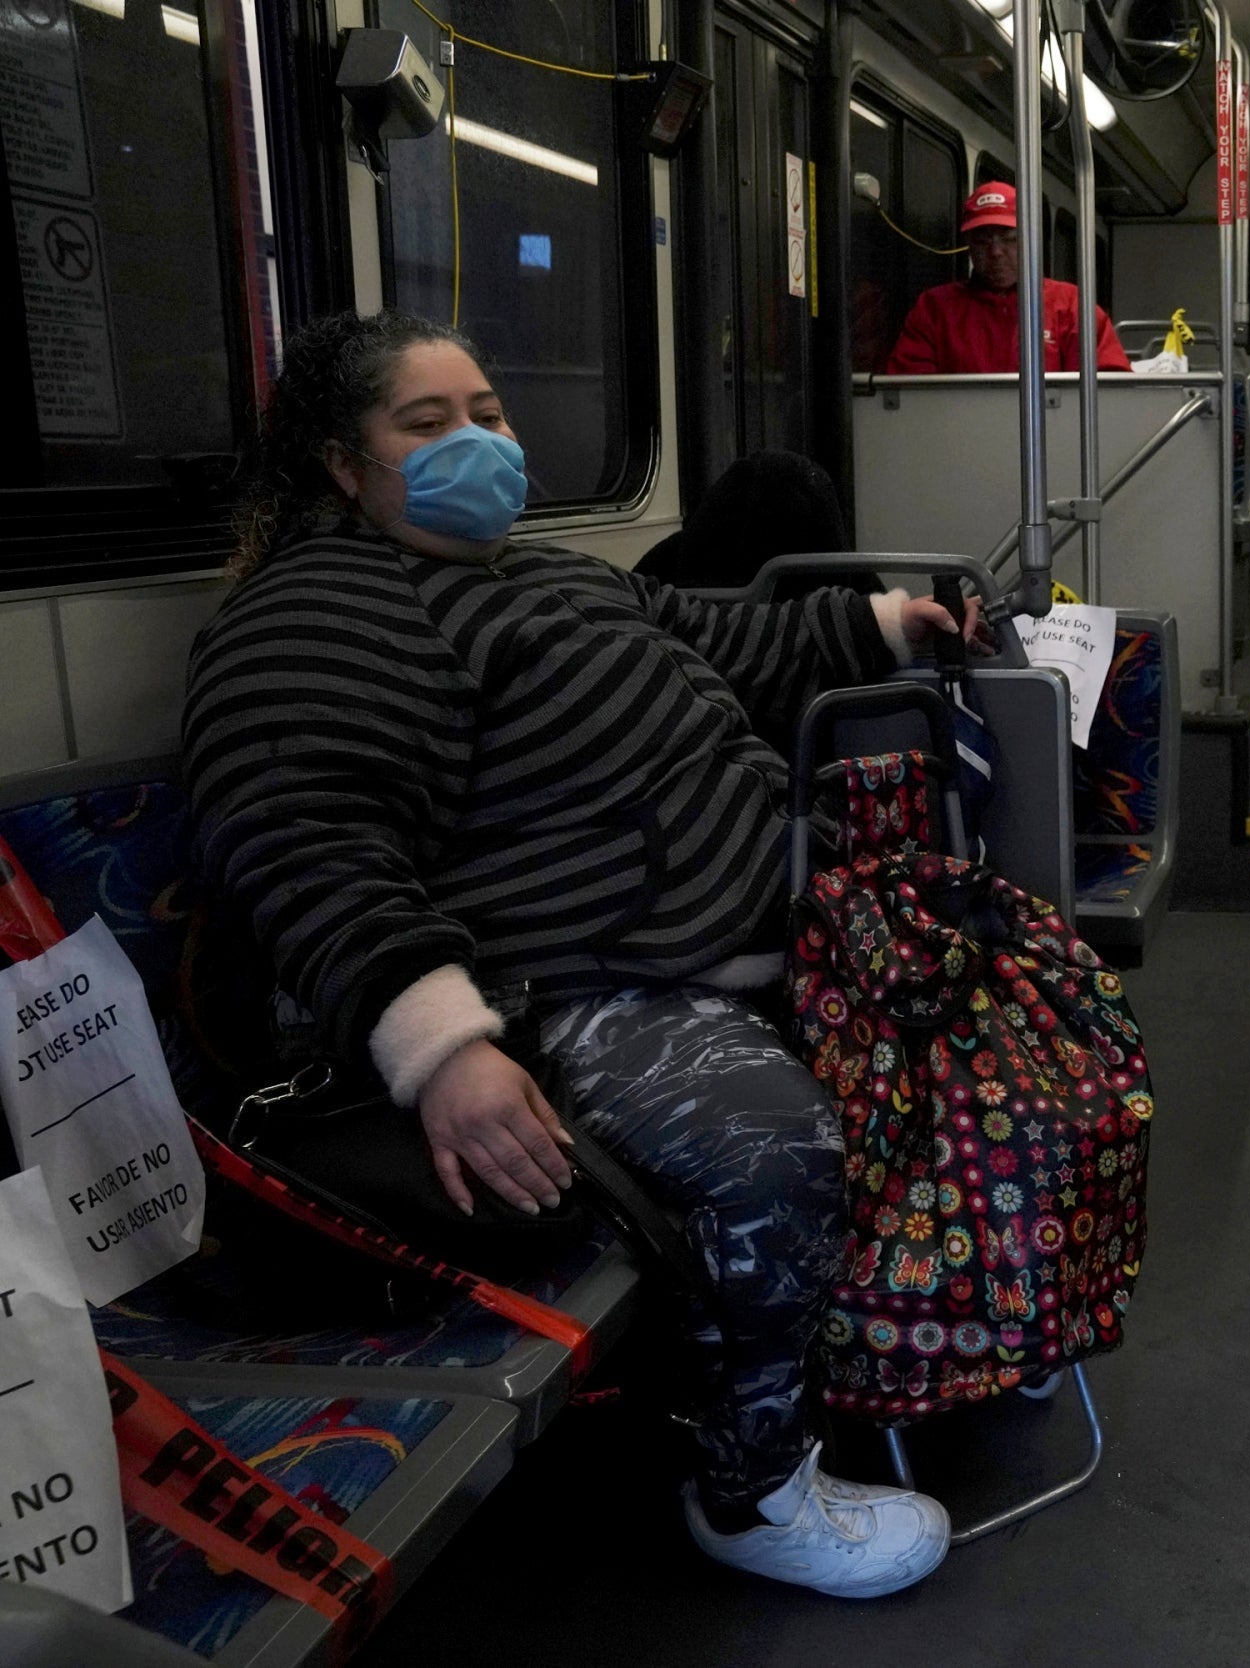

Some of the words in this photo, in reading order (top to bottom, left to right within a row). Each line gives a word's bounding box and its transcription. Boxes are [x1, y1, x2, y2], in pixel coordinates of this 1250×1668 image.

[1218, 61, 1231, 113] WATCH
[1220, 127, 1230, 166] YOUR
[1239, 137, 1249, 171] YOUR
[1220, 178, 1230, 219] STEP
[1239, 181, 1249, 214] STEP
[1042, 631, 1064, 641] USE
[1070, 636, 1096, 653] SEAT
[1074, 620, 1091, 632] DO
[17, 992, 60, 1034] EASE
[60, 973, 90, 1003] DO
[43, 1032, 74, 1063] USE
[73, 1004, 118, 1046] SEAT
[68, 1172, 120, 1215] FAVOR
[115, 1159, 141, 1188] DE
[143, 1143, 171, 1174] NO
[86, 1217, 129, 1253] USAR
[127, 1183, 188, 1234] ASIENTO
[12, 1472, 74, 1519] NO
